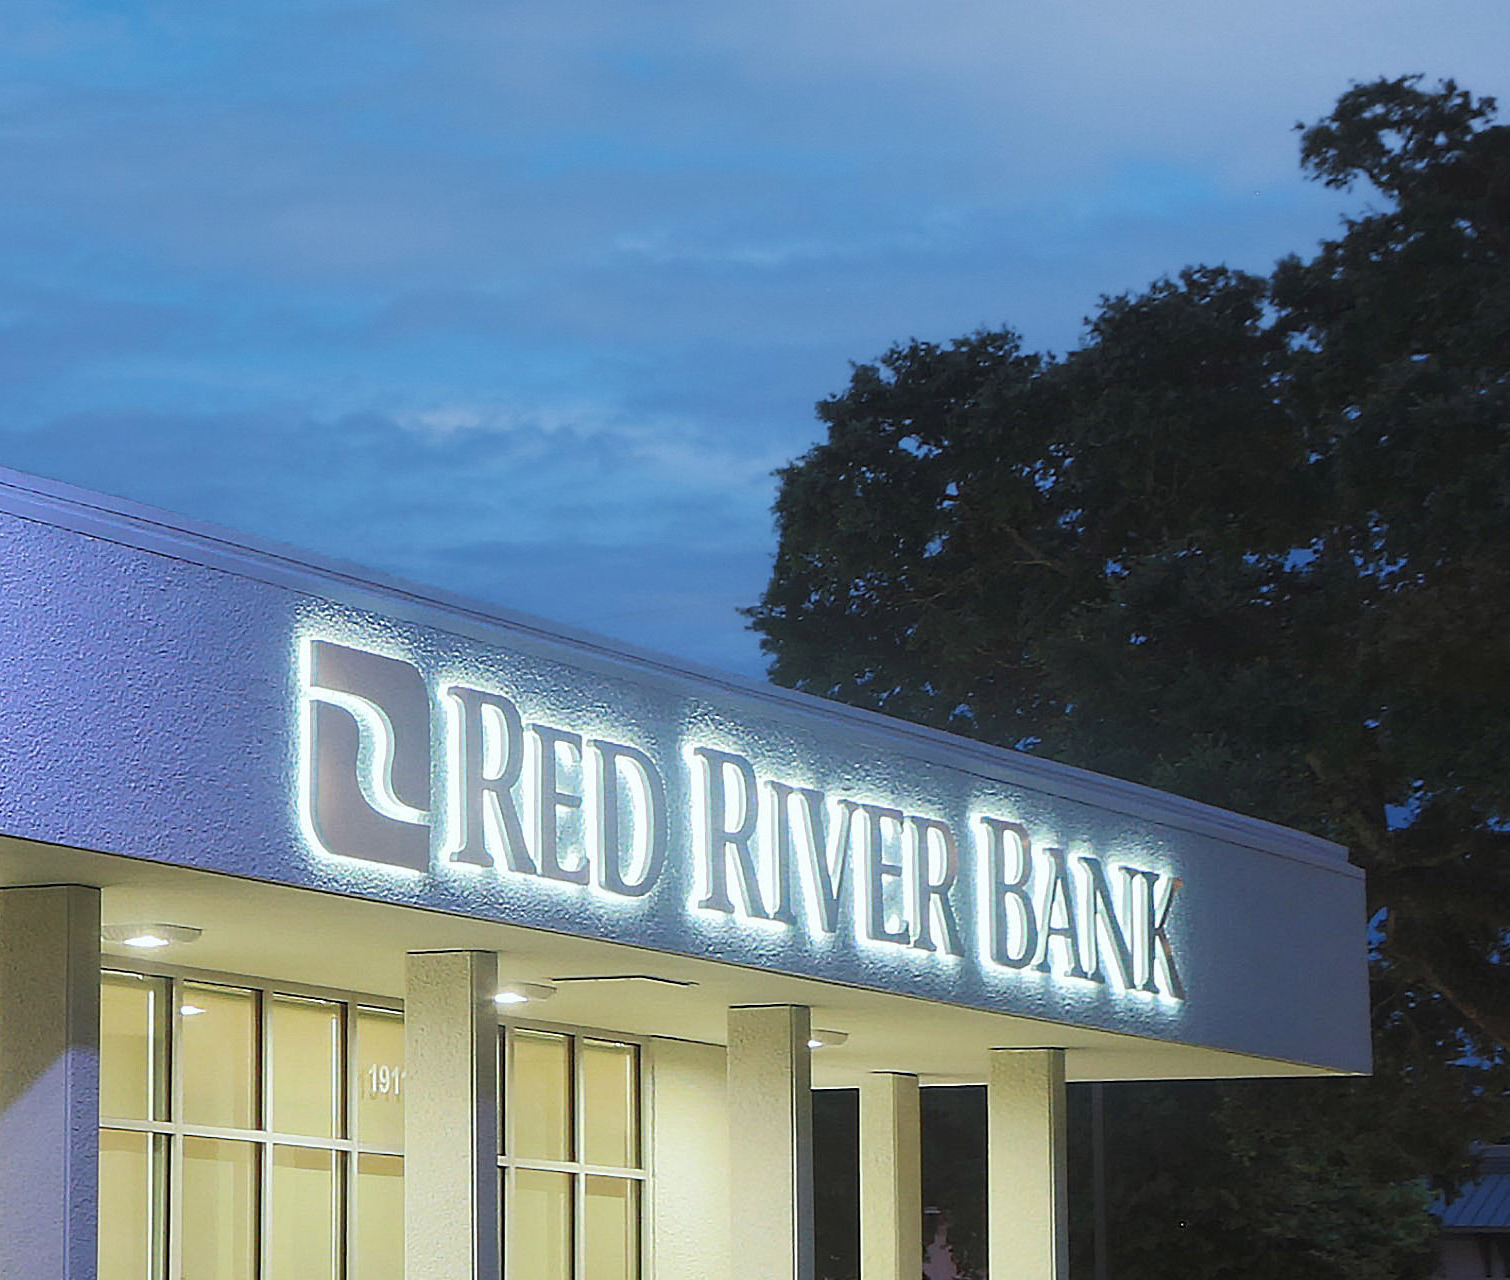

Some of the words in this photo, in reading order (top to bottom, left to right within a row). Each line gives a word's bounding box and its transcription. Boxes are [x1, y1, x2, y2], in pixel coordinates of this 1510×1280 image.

[446, 685, 670, 898] RED
[692, 745, 966, 958] RIVER
[980, 815, 1185, 1001] BANK
[368, 1063, 408, 1096] 191
